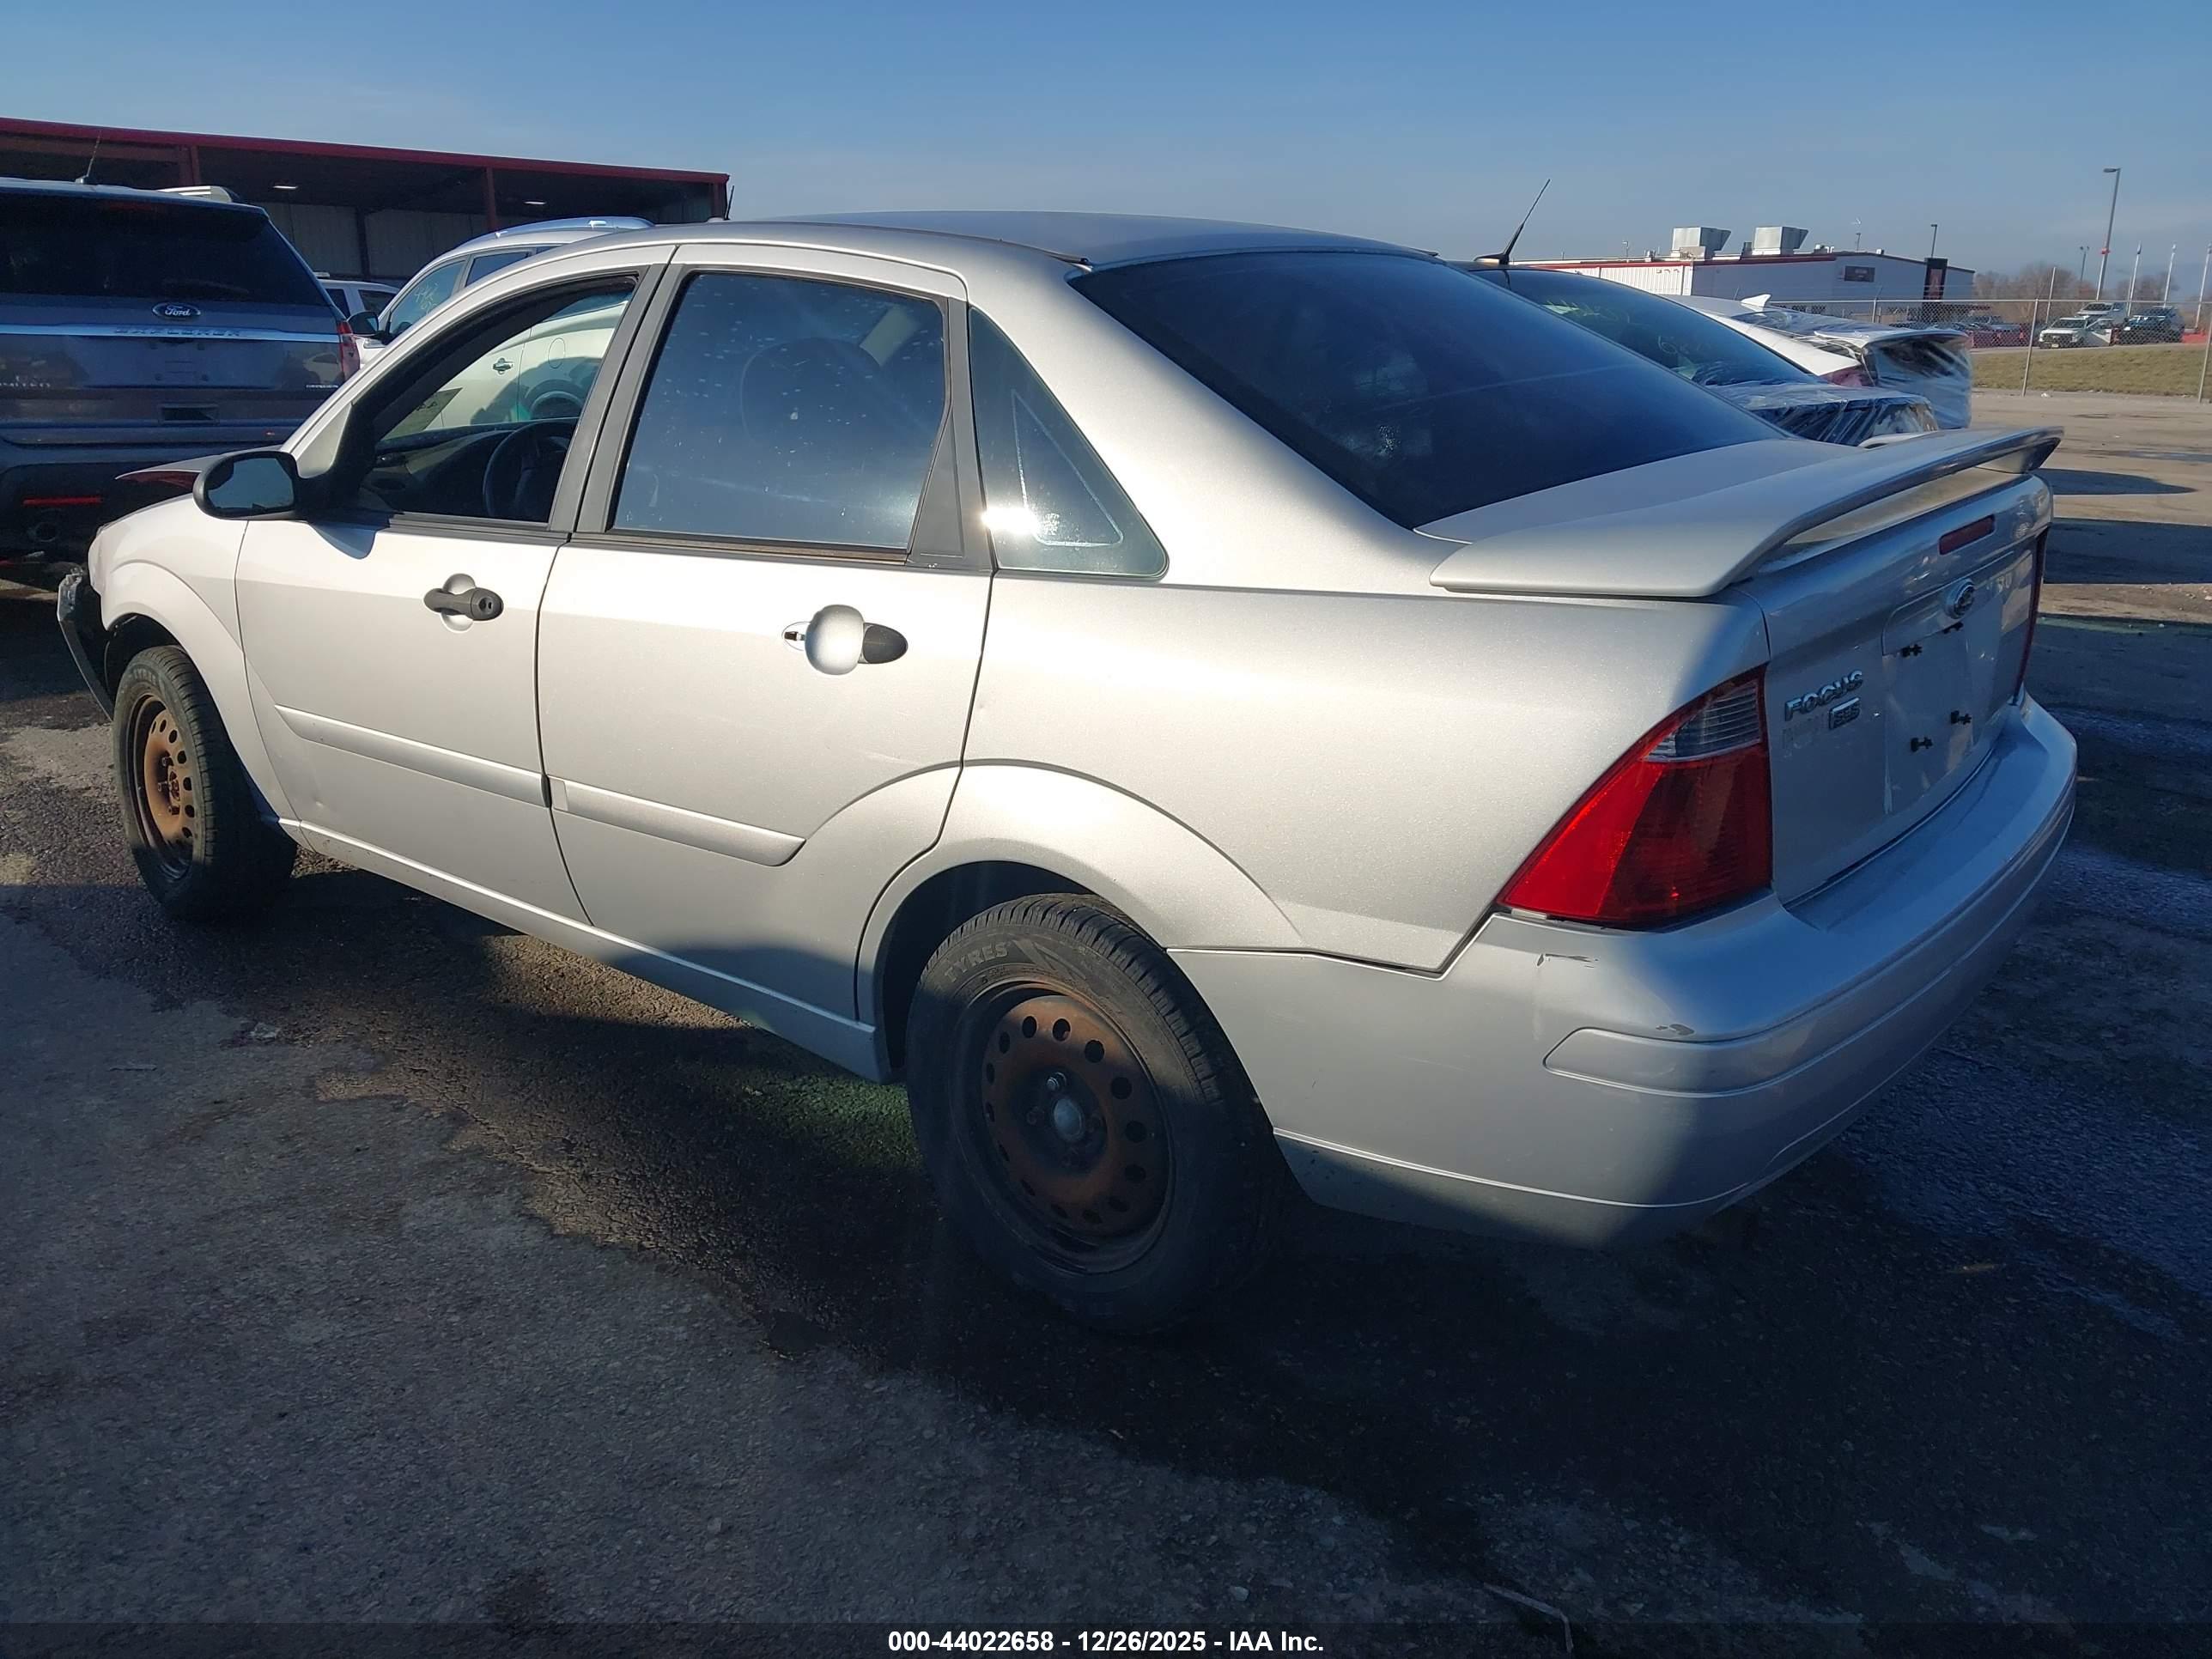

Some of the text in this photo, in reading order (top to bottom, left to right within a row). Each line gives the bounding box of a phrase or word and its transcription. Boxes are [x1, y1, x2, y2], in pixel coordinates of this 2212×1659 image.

[164, 305, 191, 317] Ford
[1785, 669, 1863, 721] FOCUS
[944, 941, 1008, 983] TYRES
